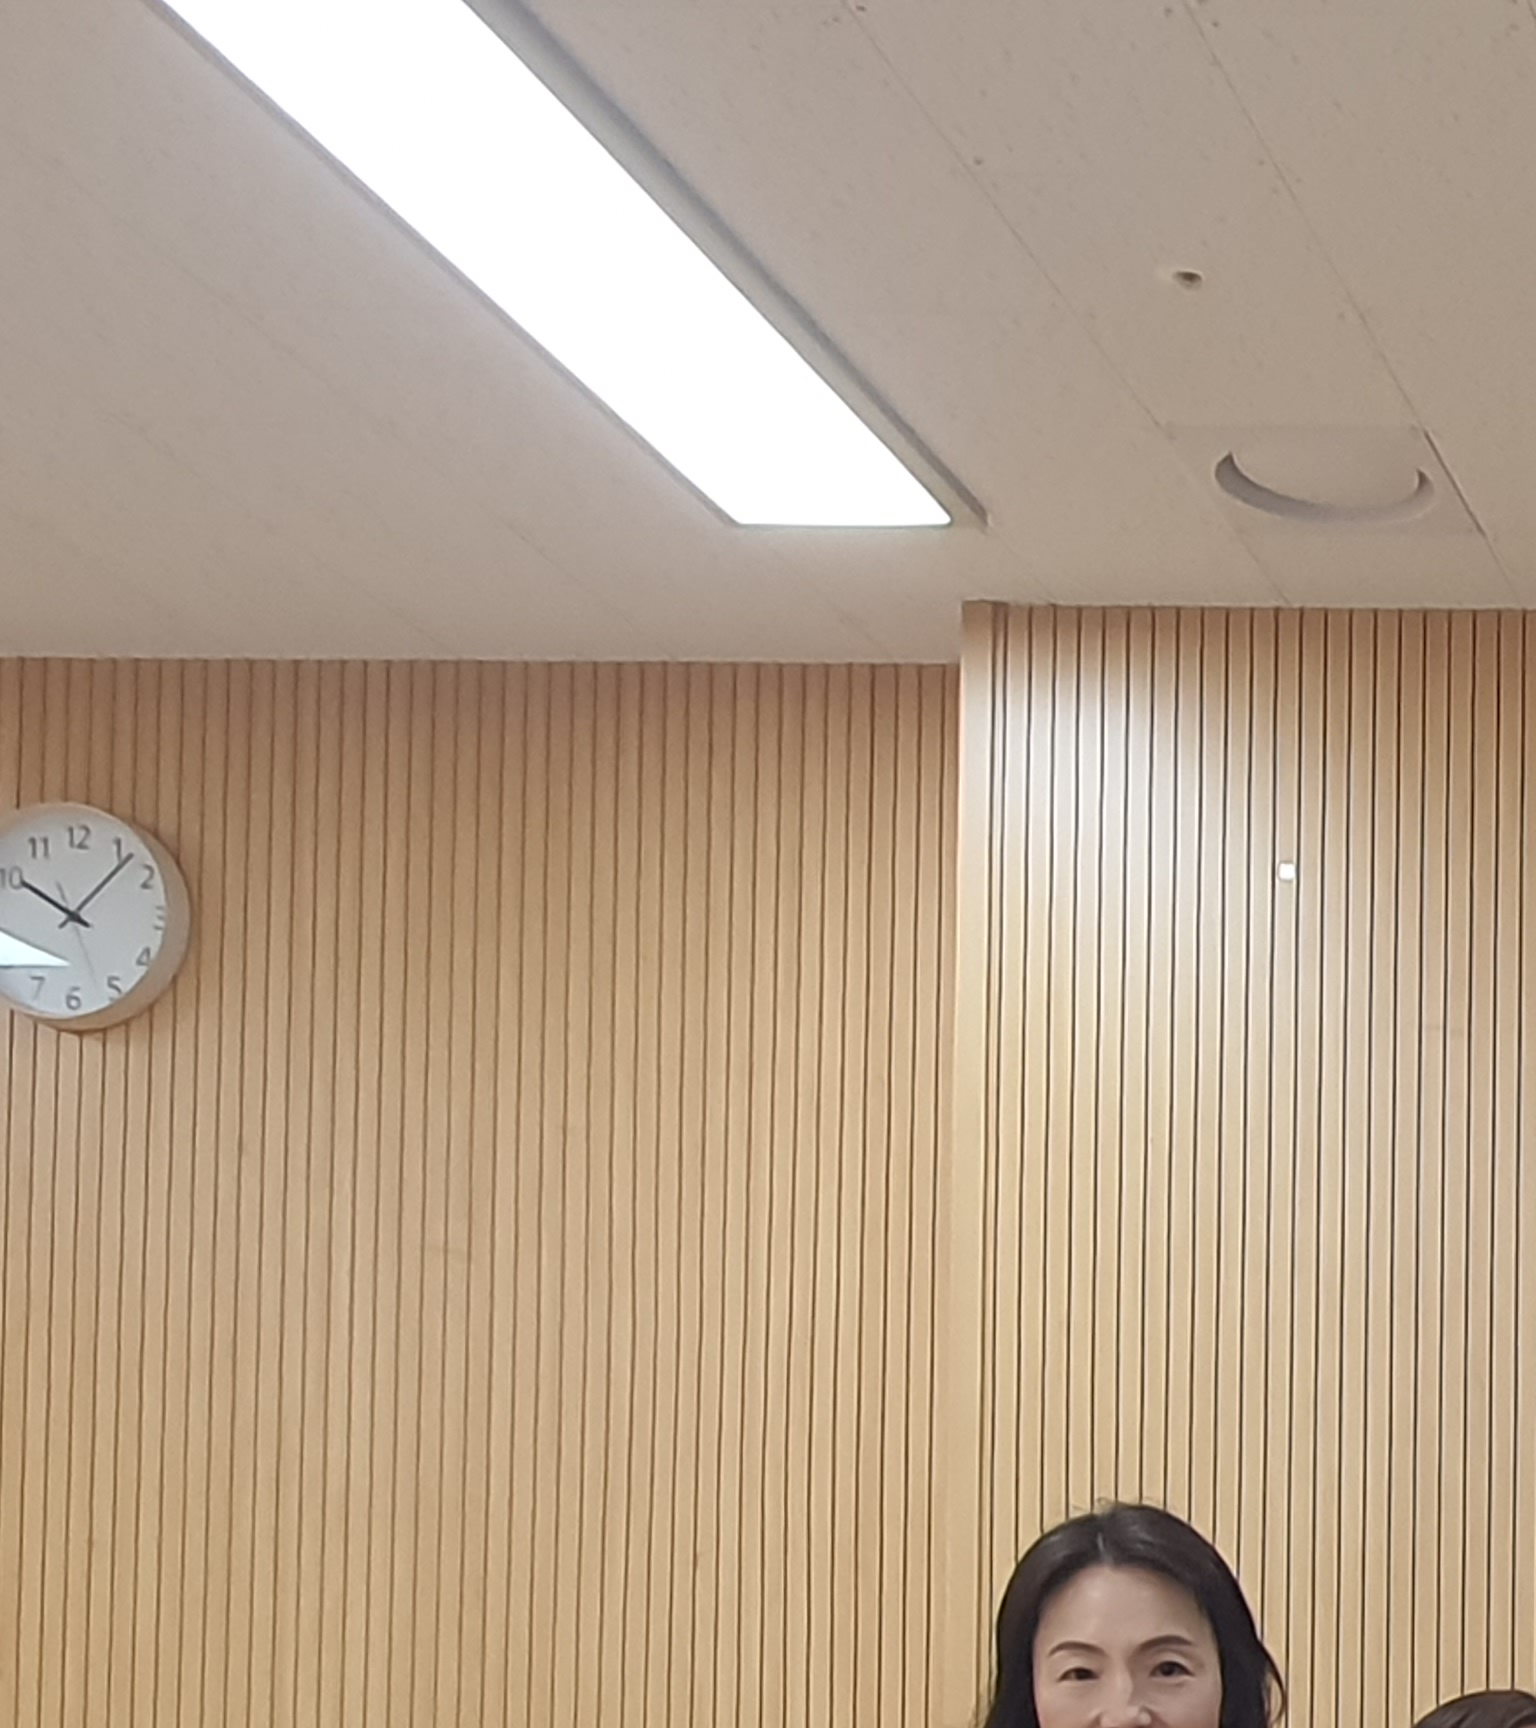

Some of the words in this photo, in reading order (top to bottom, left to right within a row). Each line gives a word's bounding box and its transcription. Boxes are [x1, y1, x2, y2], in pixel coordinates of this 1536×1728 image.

[28, 837, 50, 859] 11
[67, 825, 91, 850] 12
[140, 864, 155, 889] 2
[136, 947, 151, 966] 4
[29, 976, 45, 999] 7
[65, 987, 81, 1010] 6
[106, 976, 122, 1001] 5
